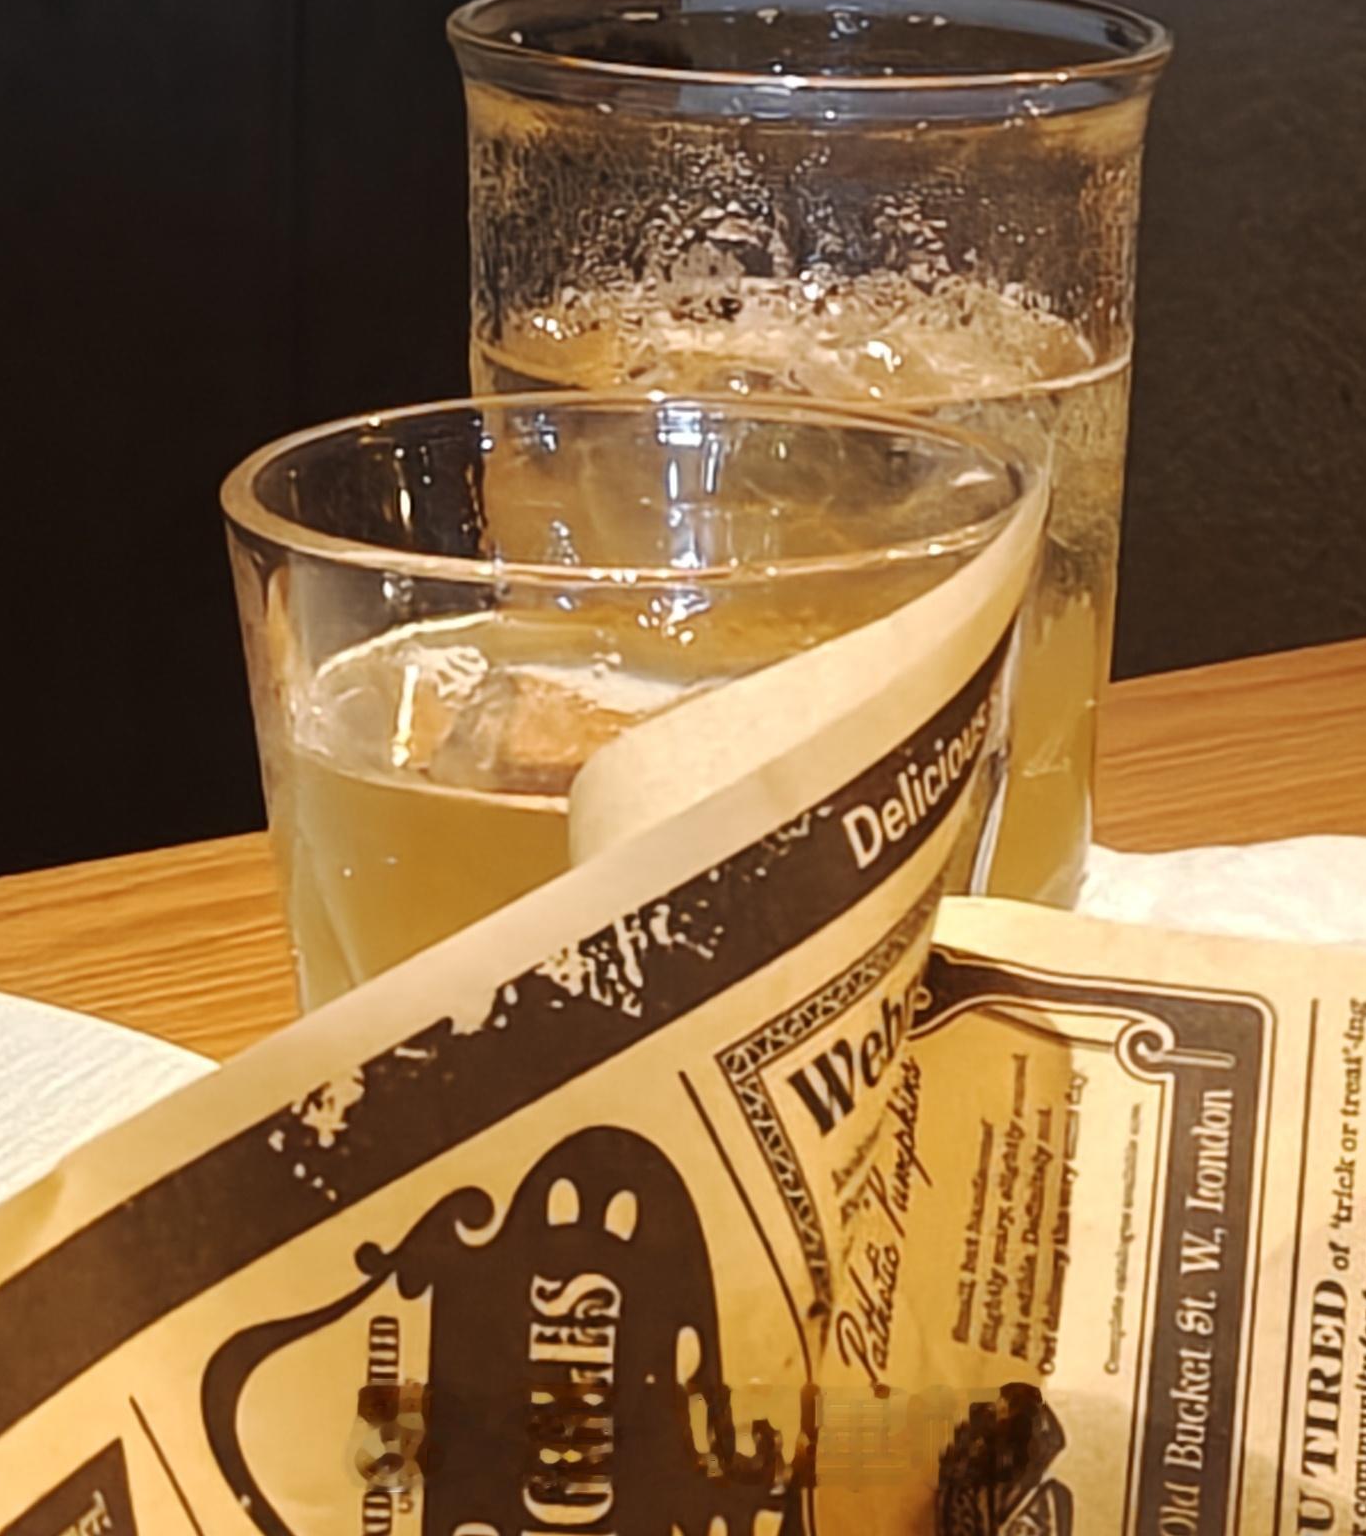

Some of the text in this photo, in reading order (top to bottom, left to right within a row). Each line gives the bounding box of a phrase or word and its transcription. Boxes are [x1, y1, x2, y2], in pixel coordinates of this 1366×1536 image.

[1184, 1088, 1234, 1213] London
[1301, 1279, 1348, 1478] TIRED
[1328, 1241, 1351, 1272] of
[1340, 1122, 1359, 1152] or
[1163, 1347, 1213, 1472] Bucket
